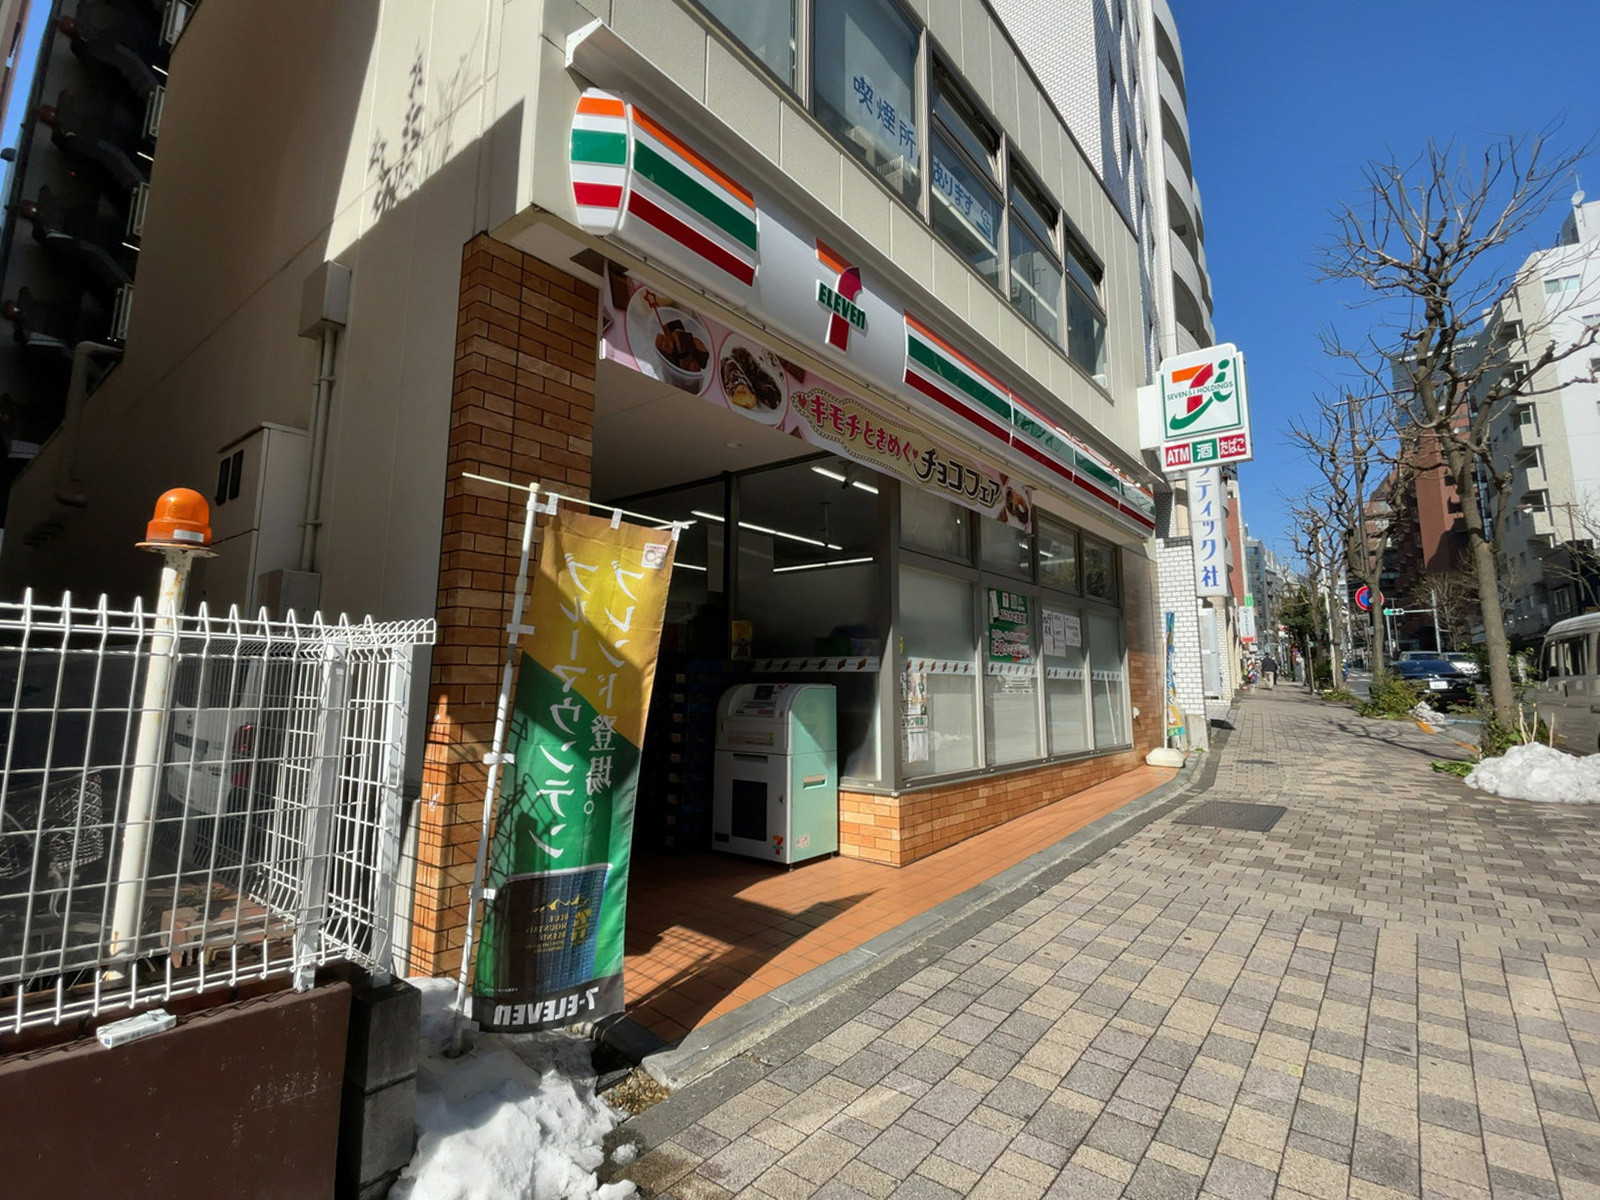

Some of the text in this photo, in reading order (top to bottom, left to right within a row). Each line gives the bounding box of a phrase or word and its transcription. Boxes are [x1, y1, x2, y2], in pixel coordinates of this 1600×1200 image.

[853, 75, 973, 216] 喫煙所 あります
[810, 396, 1001, 504] キモチときめく チョコフェア
[1167, 446, 1190, 464] ATM
[1197, 442, 1213, 460] 酒
[1220, 438, 1245, 455] たばこ
